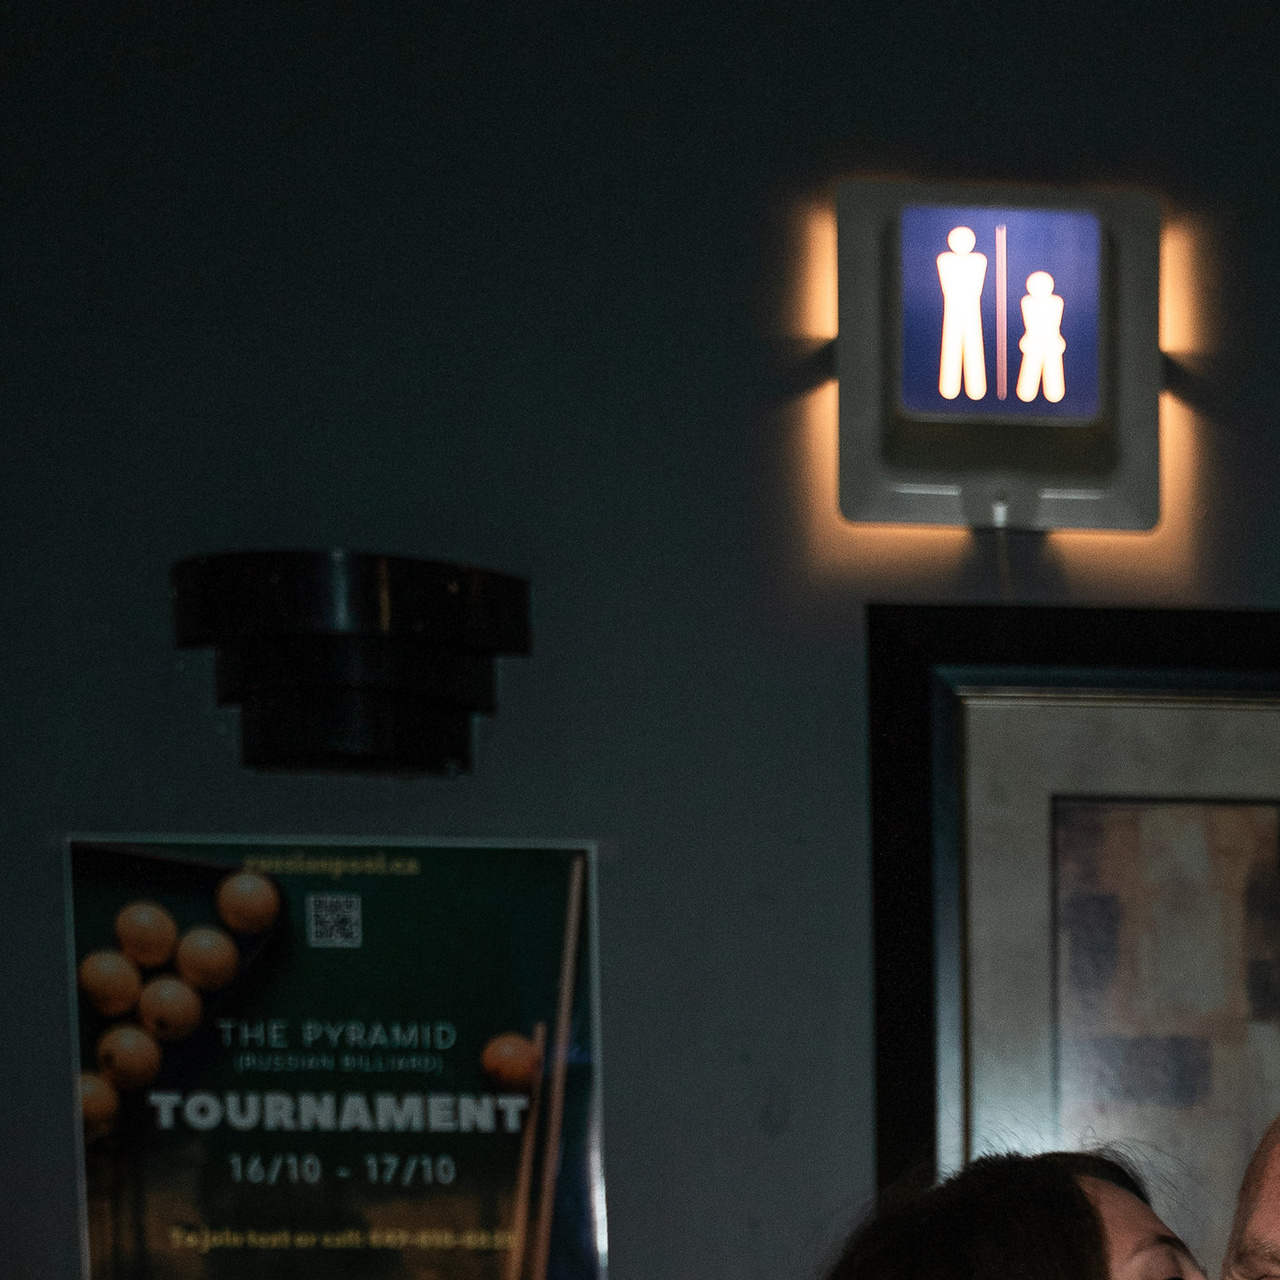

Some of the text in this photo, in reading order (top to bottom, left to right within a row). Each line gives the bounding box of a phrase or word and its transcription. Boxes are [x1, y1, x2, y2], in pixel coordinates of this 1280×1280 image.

[217, 1018, 457, 1050] THE PYRAMID
[236, 1051, 335, 1072] (RUSSIAN
[148, 1090, 530, 1133] TOURNAMENT
[229, 1154, 320, 1185] 16/10
[365, 1154, 456, 1185] 17/10
